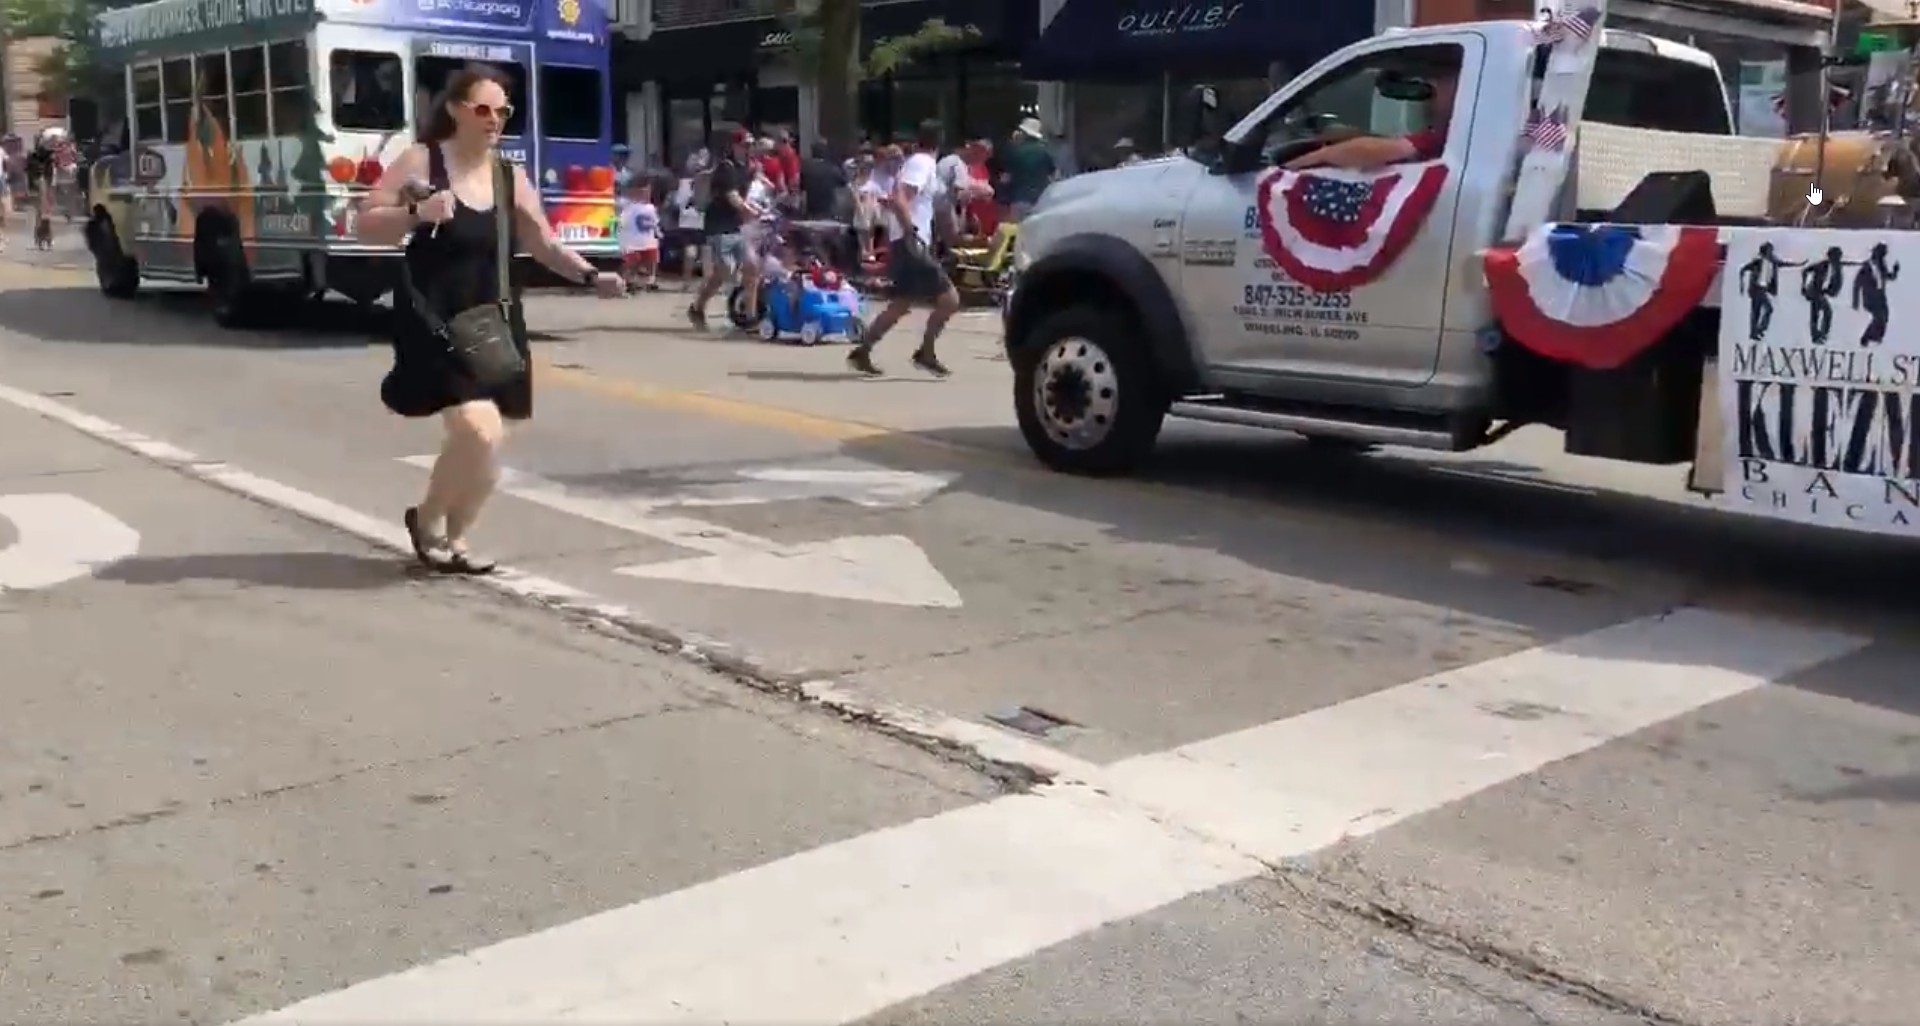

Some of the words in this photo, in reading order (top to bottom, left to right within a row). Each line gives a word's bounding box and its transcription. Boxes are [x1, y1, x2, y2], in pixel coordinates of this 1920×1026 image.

[1244, 285, 1351, 308] 847-325-5255
[1345, 311, 1370, 323] AVE
[1732, 343, 1881, 385] MAXWELL
[1741, 484, 1911, 526] CHICA
